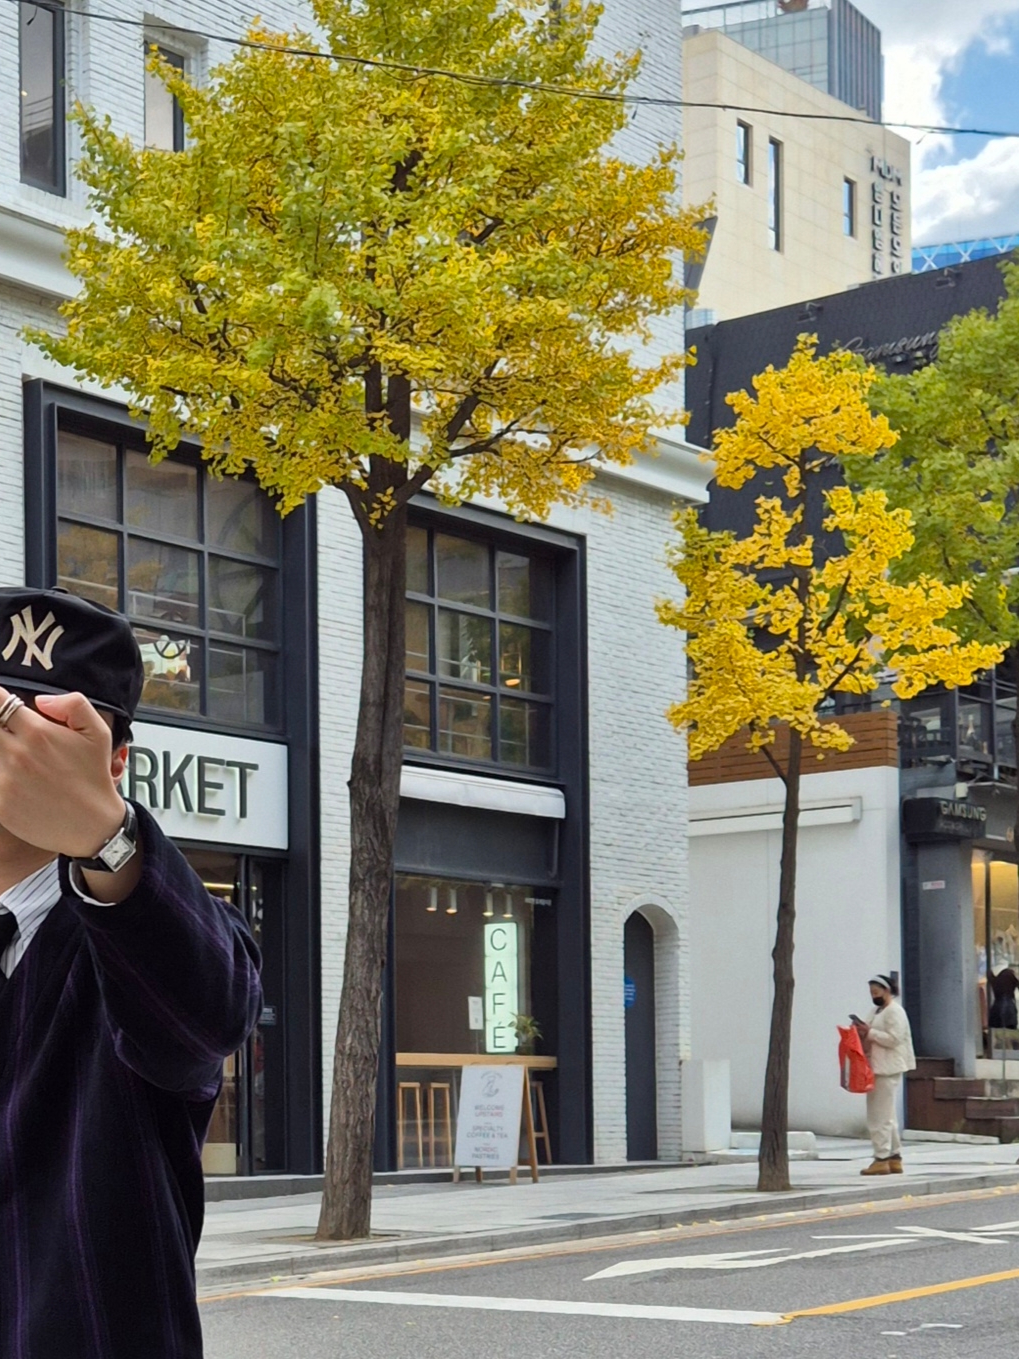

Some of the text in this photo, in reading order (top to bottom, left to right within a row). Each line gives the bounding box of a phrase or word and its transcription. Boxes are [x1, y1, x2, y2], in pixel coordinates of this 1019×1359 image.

[1, 605, 65, 671] NY
[119, 745, 259, 819] RKET
[490, 928, 507, 1049] CAFÉ
